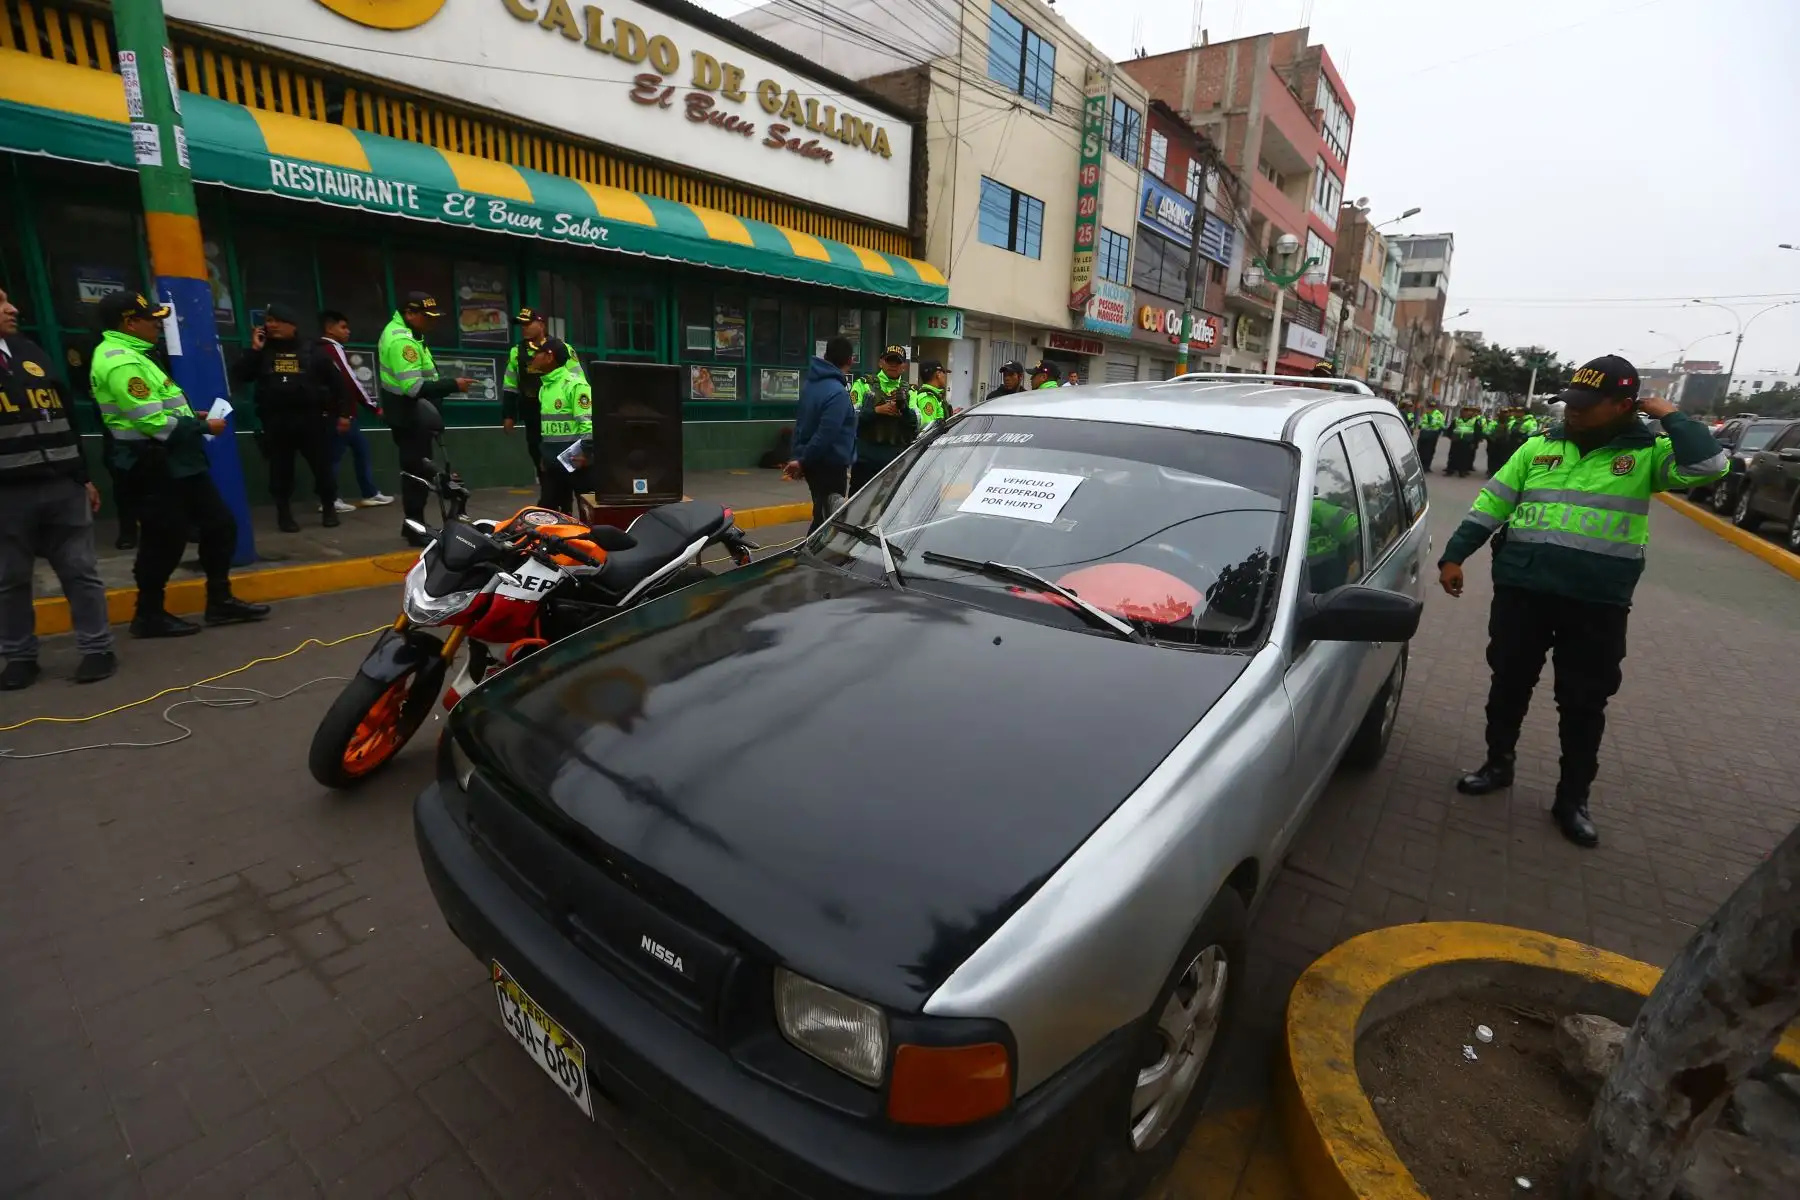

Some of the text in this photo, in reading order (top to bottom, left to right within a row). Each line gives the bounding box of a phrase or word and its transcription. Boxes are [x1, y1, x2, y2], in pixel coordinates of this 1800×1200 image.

[691, 50, 747, 102] DE
[757, 79, 893, 160] GALLINA
[629, 73, 834, 164] El Buen Sabor
[1082, 166, 1096, 186] 15
[269, 159, 609, 242] RESTAURANTE El Buen Sabor
[1080, 196, 1095, 214] 20
[1078, 225, 1092, 243] 25
[1098, 298, 1124, 314] PESCADOS
[1096, 310, 1123, 324] MARISCOS
[0, 392, 20, 412] L
[1003, 477, 1055, 488] VEHICULO
[985, 486, 1056, 500] RECUPERADO
[981, 497, 1043, 510] POR HURTO
[455, 535, 476, 549] HONDA
[641, 935, 684, 973] NISSA
